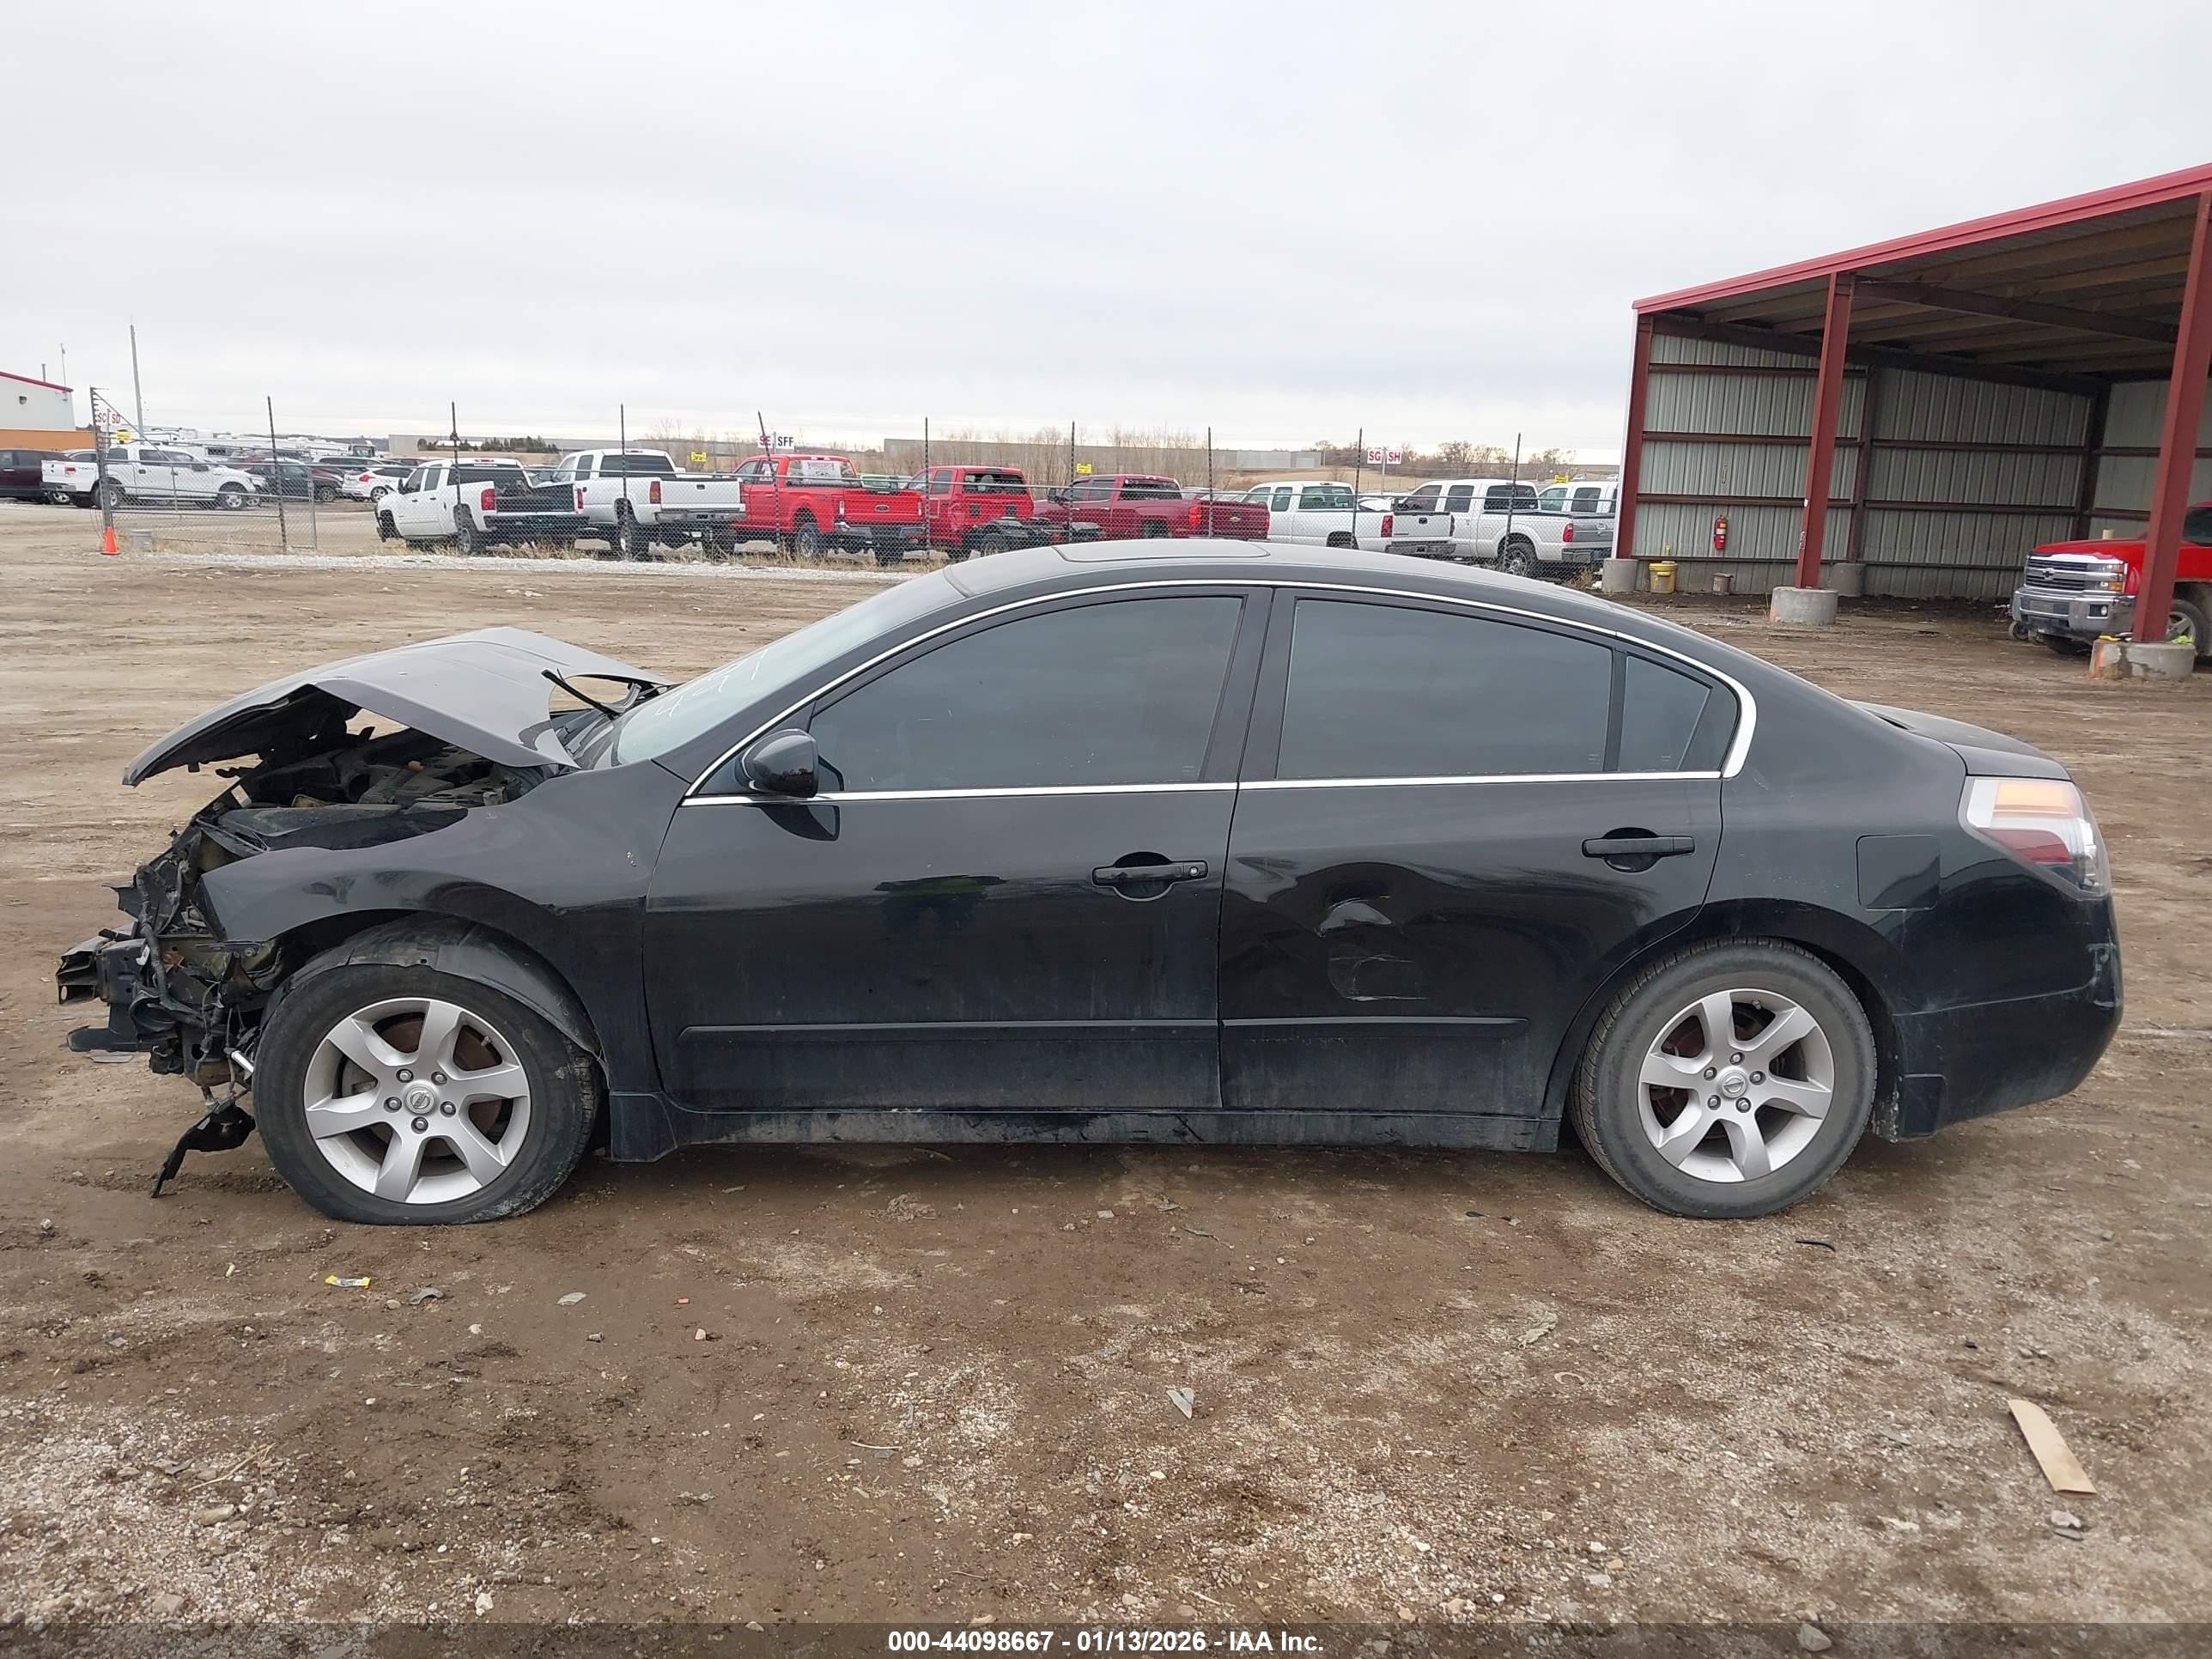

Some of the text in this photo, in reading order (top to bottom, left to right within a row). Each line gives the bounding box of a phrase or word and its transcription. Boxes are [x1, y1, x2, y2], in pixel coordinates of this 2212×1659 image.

[112, 413, 121, 424] SD
[777, 436, 794, 447] SFF
[1369, 451, 1381, 461] SG
[1388, 452, 1401, 462] SH
